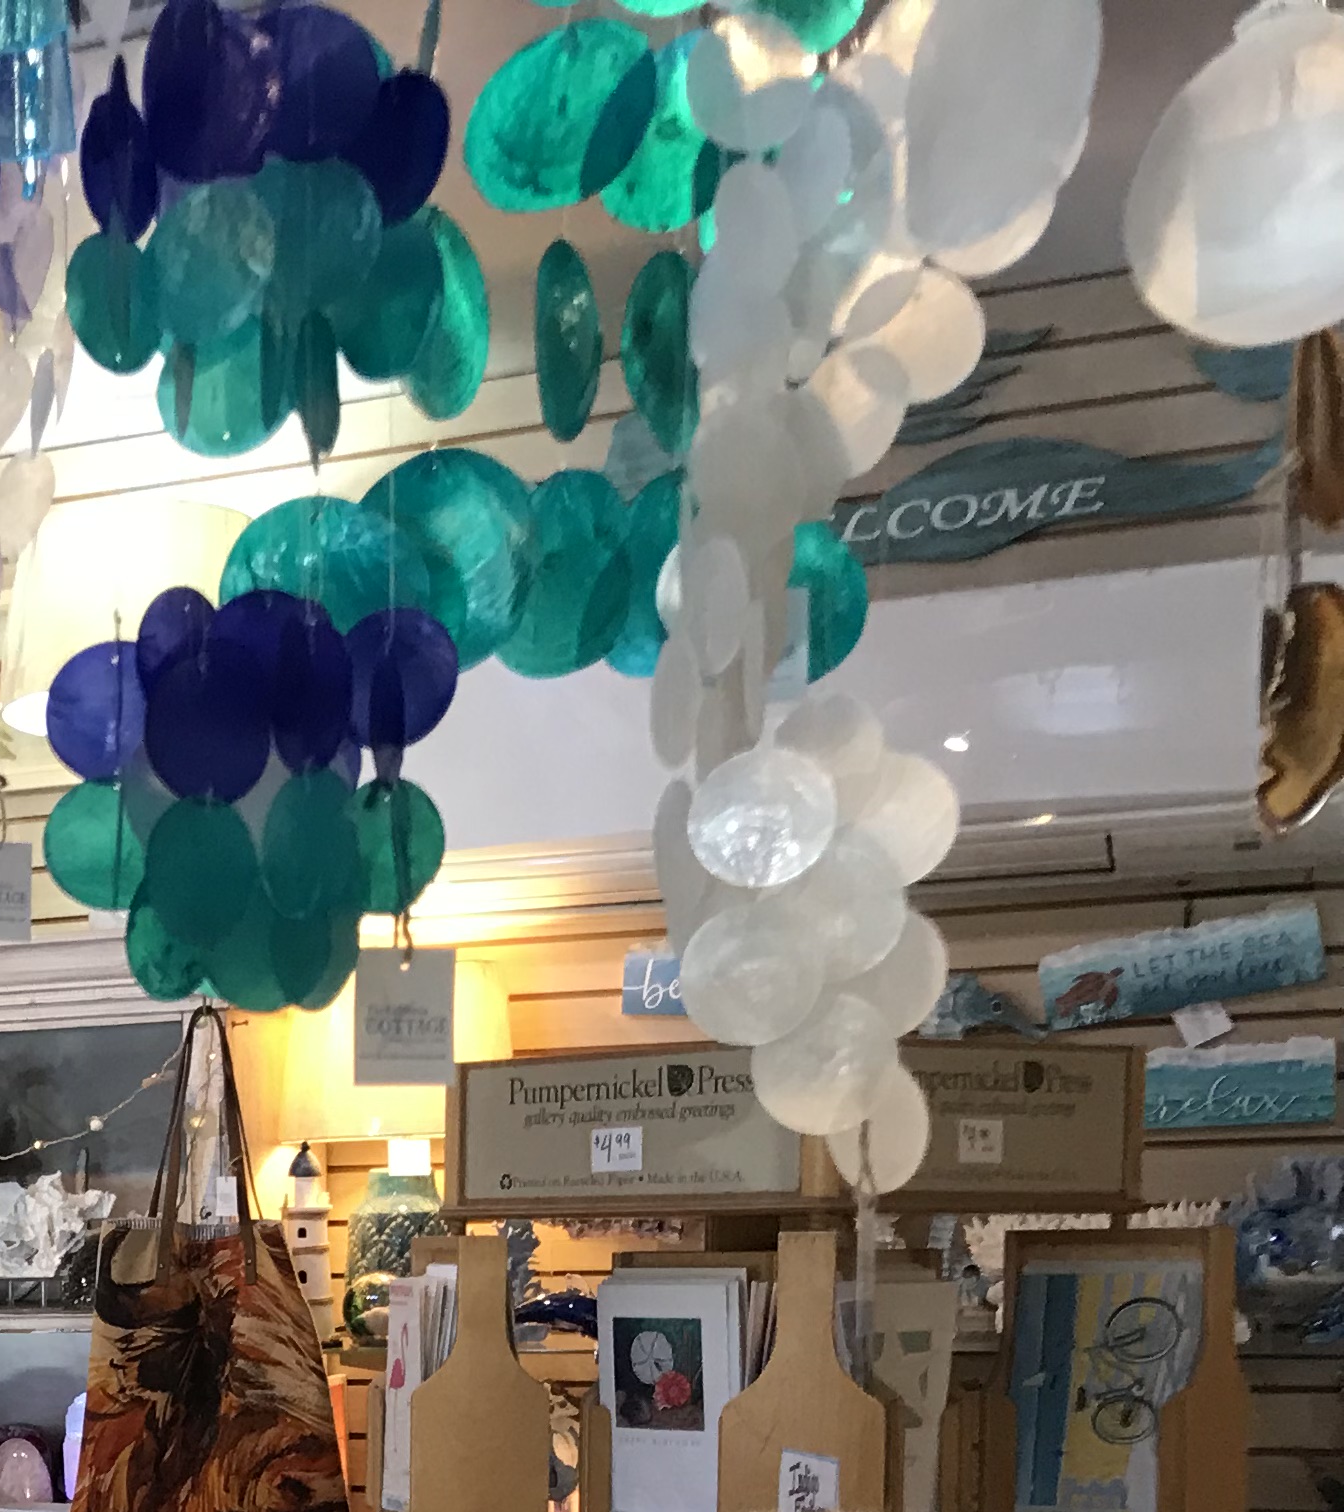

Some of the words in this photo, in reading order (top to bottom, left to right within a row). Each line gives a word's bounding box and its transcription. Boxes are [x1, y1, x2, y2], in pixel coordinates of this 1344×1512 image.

[828, 476, 1106, 543] LCOME
[1131, 953, 1175, 979] LET
[1185, 941, 1234, 967] THE
[1241, 930, 1295, 952] SEA
[508, 1066, 663, 1107] Pumpernickel
[1147, 1073, 1300, 1124] relax
[567, 1106, 612, 1125] quality
